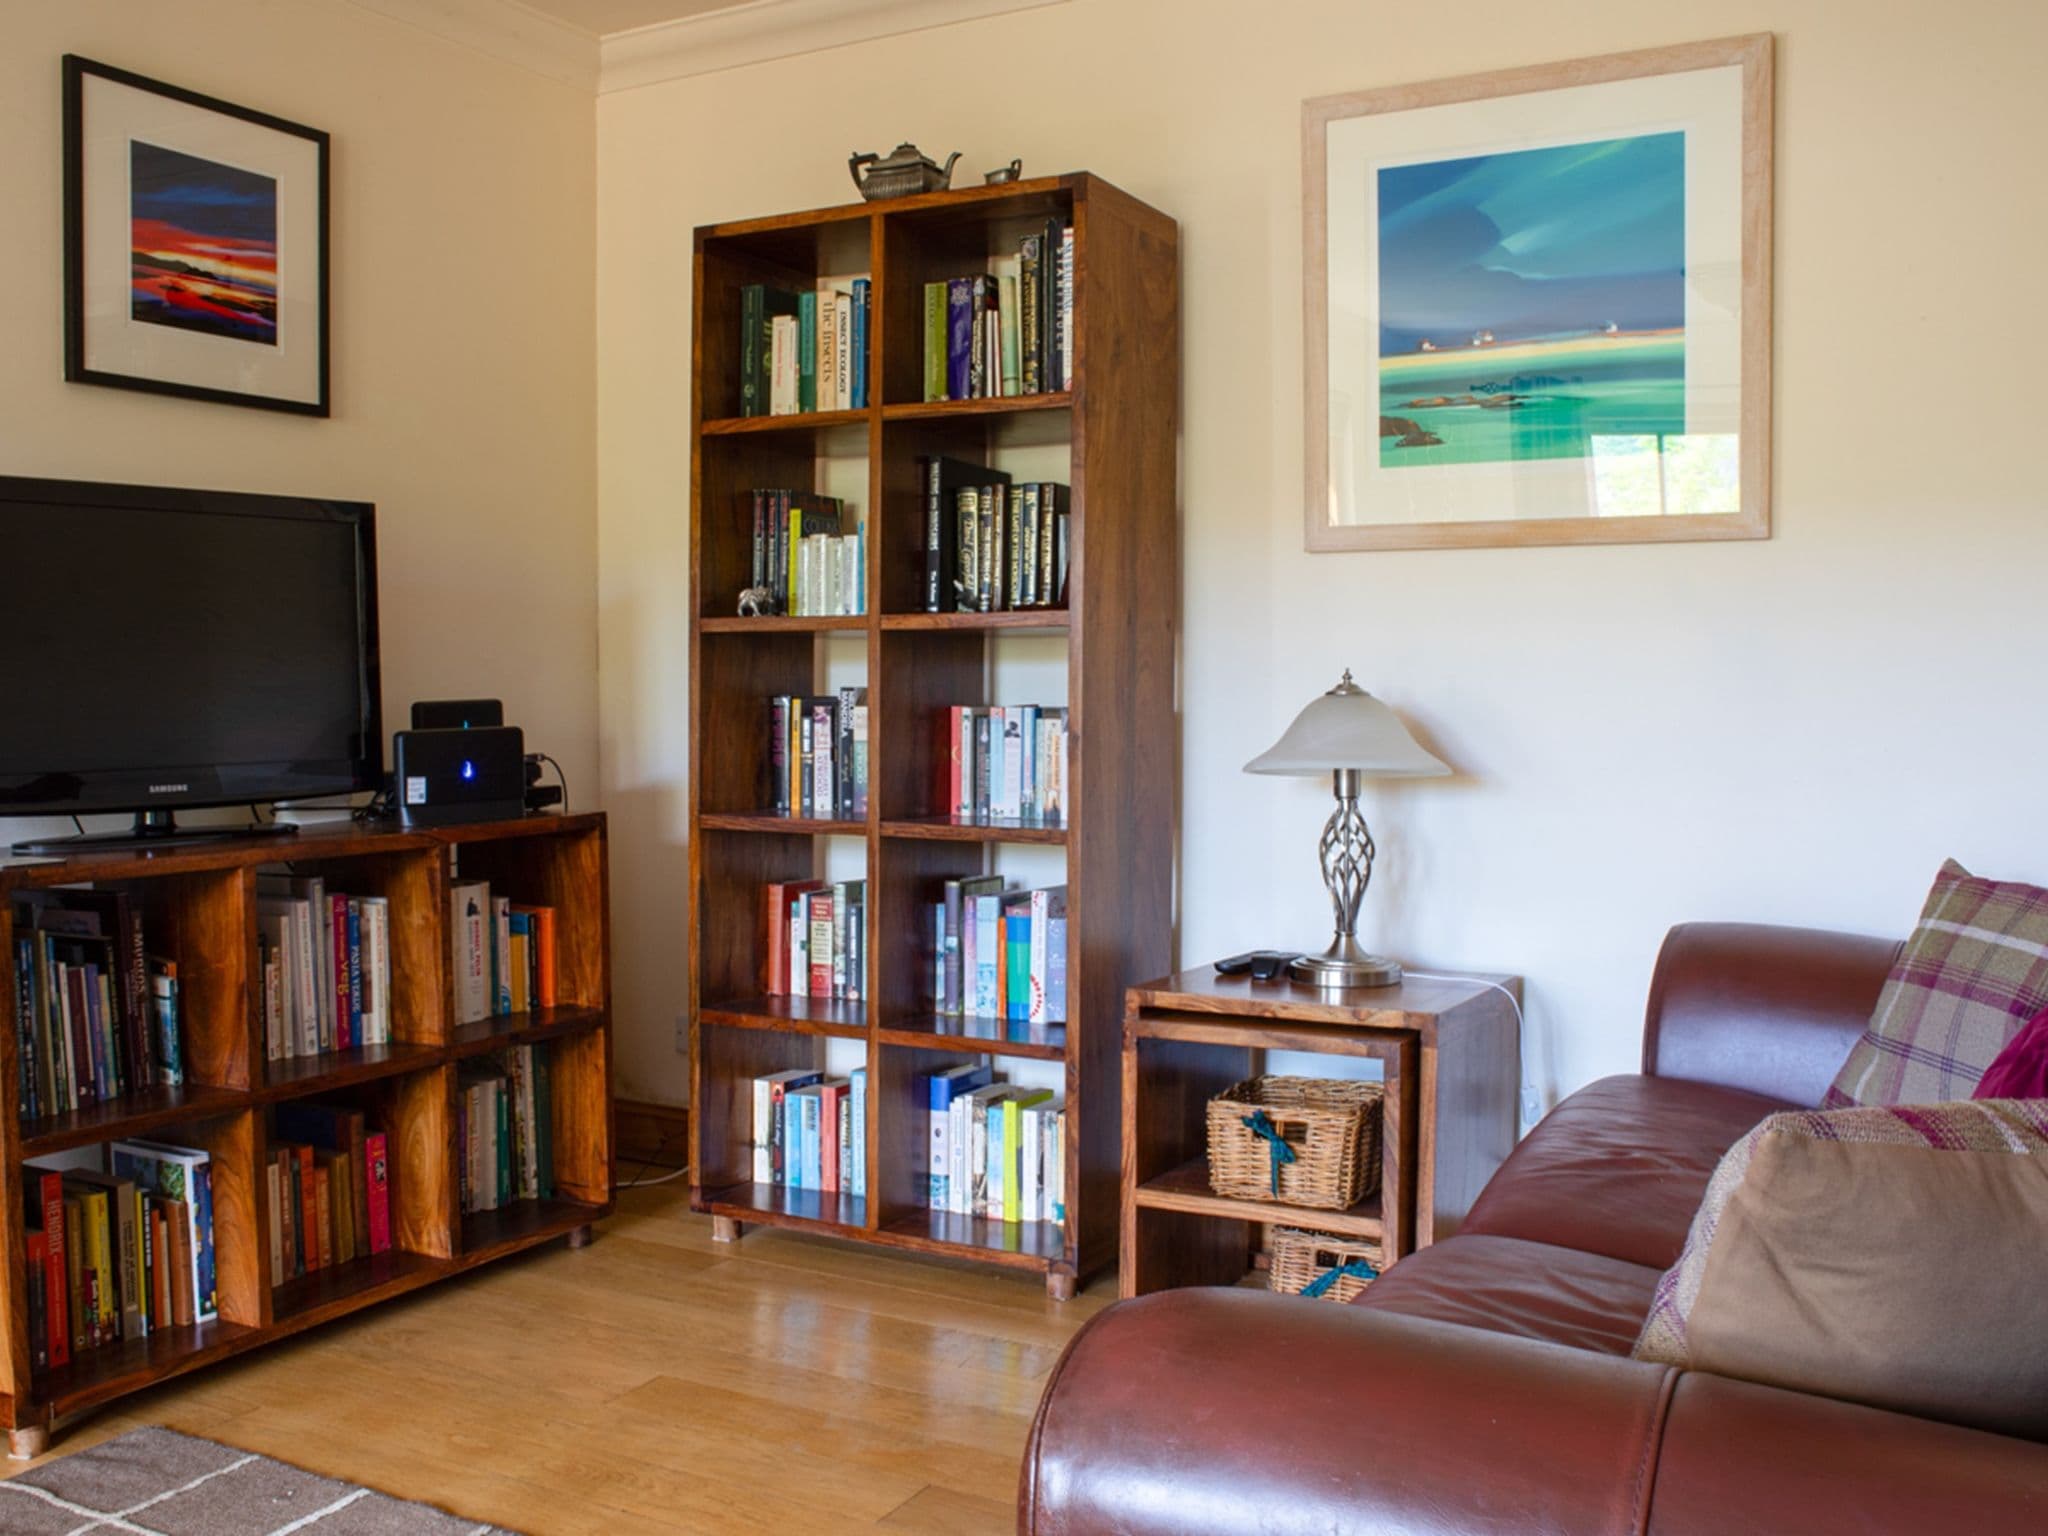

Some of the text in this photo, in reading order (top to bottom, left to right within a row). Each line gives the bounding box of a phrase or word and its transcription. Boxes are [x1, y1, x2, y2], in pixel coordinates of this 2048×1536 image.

[823, 331, 836, 383] insects
[839, 312, 848, 394] INSECT ECOLOGY
[149, 784, 188, 793] SAMSUNG
[337, 960, 349, 996] veg
[48, 1200, 62, 1256] HENDRIX
